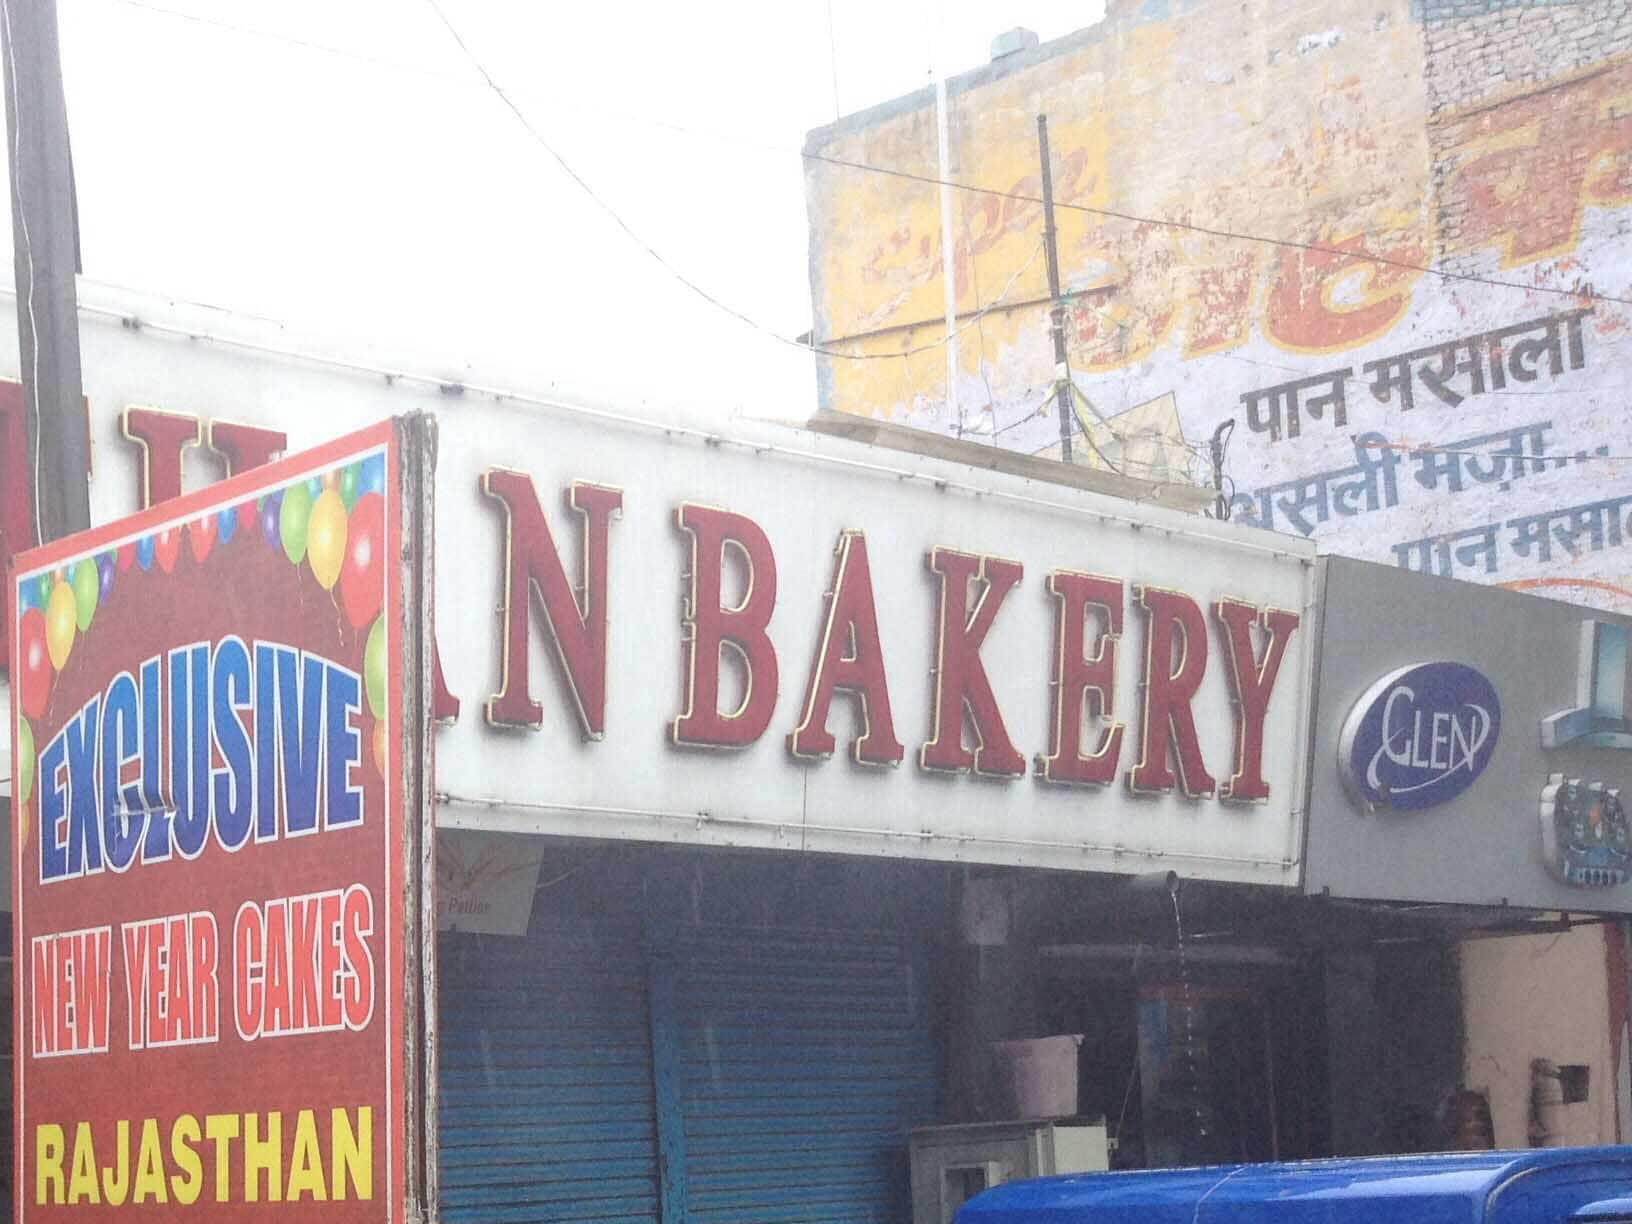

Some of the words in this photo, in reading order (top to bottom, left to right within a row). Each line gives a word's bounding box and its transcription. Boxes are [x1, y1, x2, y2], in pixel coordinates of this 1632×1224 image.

[1240, 366, 1353, 442] पान
[1362, 306, 1596, 412] मसाला
[1231, 431, 1401, 537] असली
[668, 501, 1300, 805] BAKERY
[39, 634, 365, 886] EXCLUSIVE
[1380, 685, 1480, 774] GLEN
[31, 926, 112, 1058] NEW
[121, 910, 219, 1050] YEAR
[233, 883, 375, 1042] CAKES
[35, 1106, 372, 1206] RAJASTHAN
